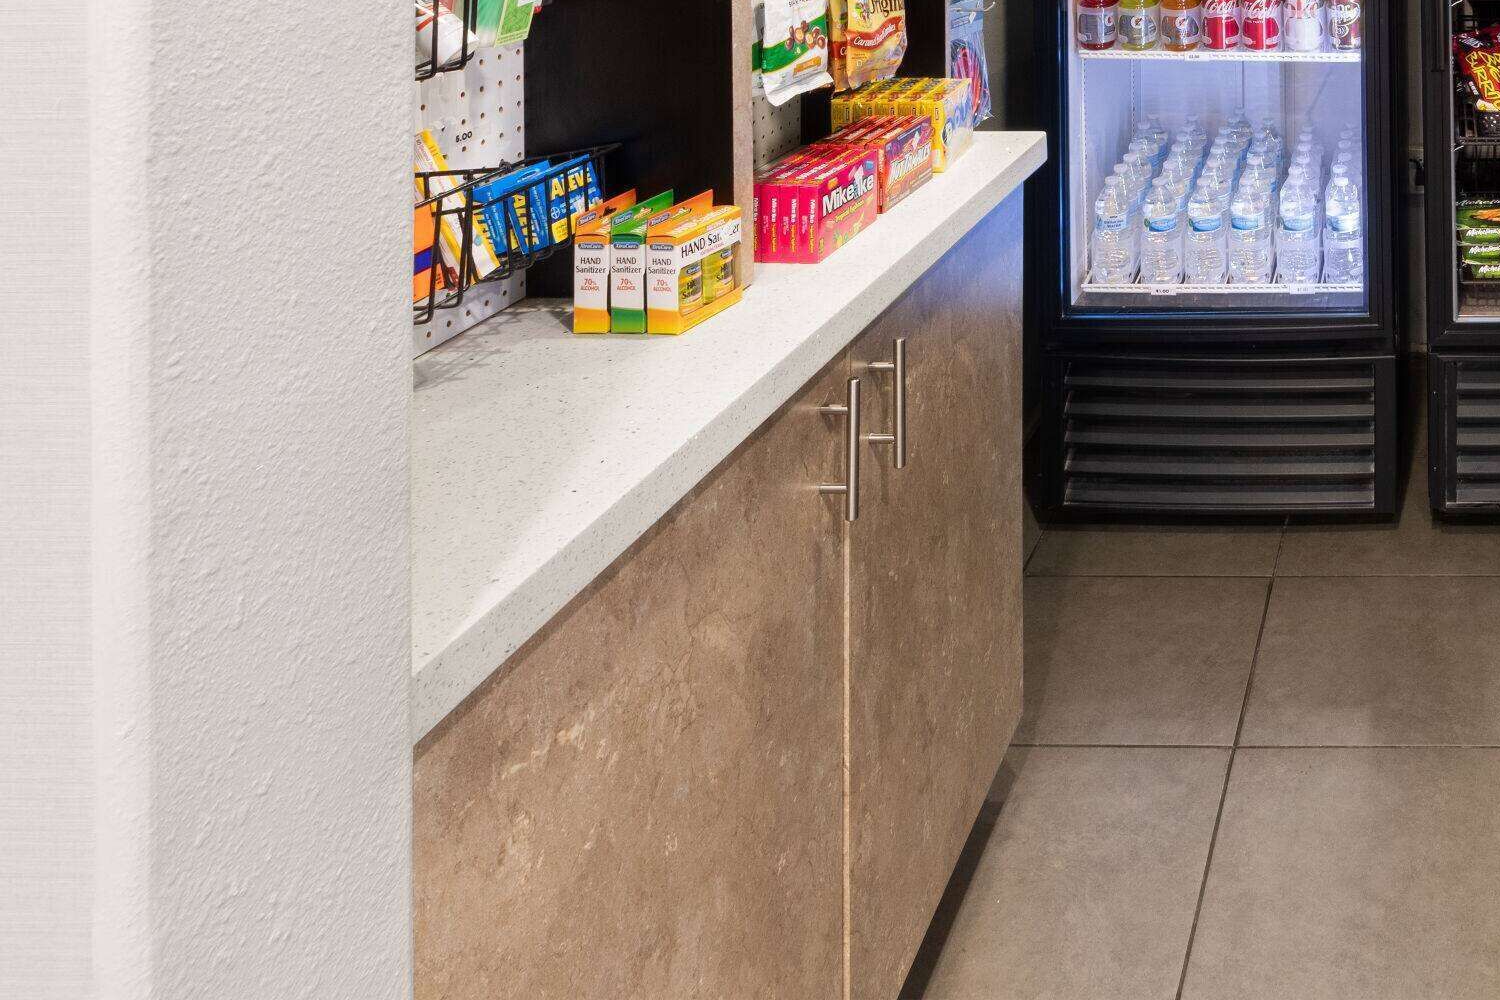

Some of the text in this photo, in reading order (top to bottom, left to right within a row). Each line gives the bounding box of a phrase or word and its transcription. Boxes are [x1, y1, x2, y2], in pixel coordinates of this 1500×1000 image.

[822, 186, 855, 218] Mike
[680, 238, 705, 259] HAND
[580, 257, 601, 265] HAND
[616, 257, 637, 265] HAND
[652, 258, 672, 266] HAND
[575, 265, 606, 274] Sanitizer
[611, 265, 642, 274] Sanitizer
[648, 267, 676, 275] Sanitizer
